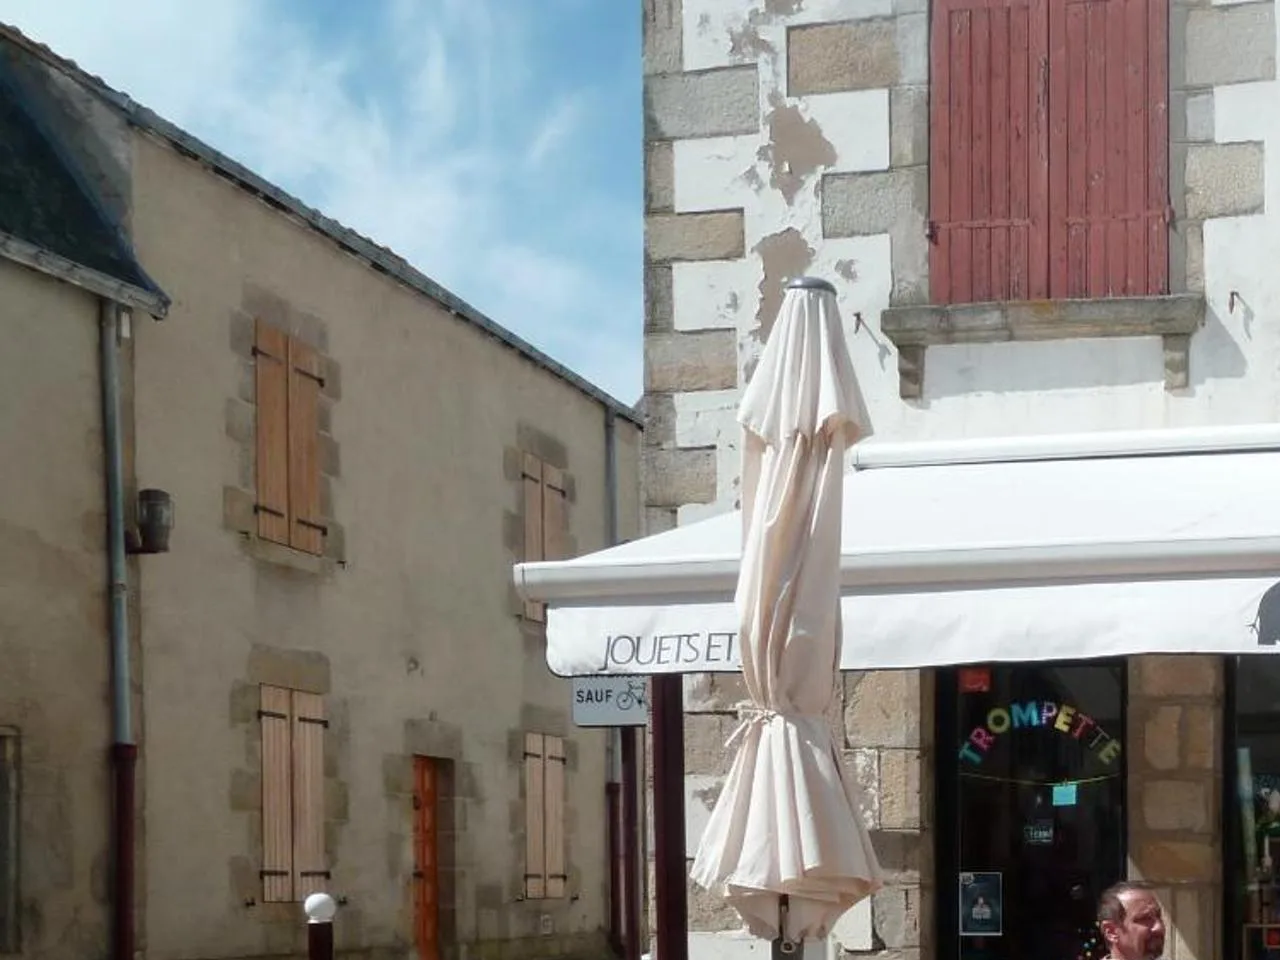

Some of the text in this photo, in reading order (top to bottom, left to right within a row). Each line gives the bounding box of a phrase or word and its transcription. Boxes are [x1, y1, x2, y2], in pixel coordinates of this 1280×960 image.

[598, 633, 737, 671] JOUETS ET
[576, 688, 613, 704] SAUF
[958, 701, 1121, 765] TROMPETTE
